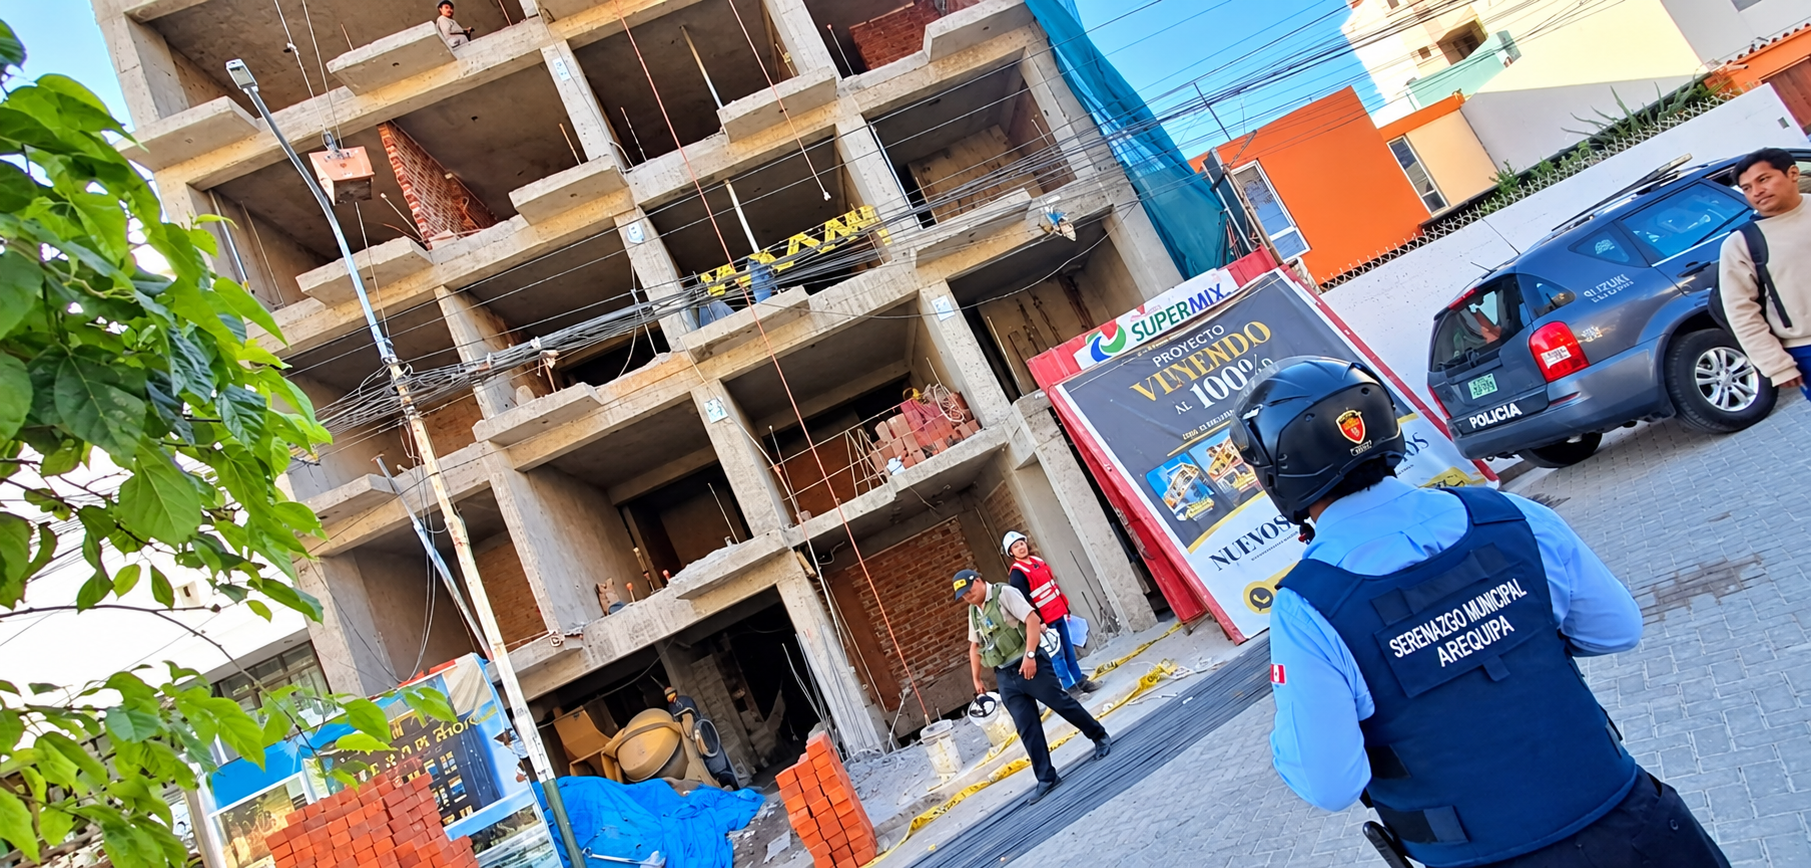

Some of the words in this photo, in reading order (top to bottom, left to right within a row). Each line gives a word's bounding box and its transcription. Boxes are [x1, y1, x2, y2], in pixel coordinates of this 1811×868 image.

[1131, 283, 1225, 342] SUPERMIX
[1152, 324, 1225, 368] PROYECTO
[1174, 401, 1193, 415] AL
[1189, 354, 1273, 410] 100%
[1469, 403, 1523, 429] POLICIA
[1208, 515, 1292, 572] NUEVOS
[1389, 608, 1467, 658] SERENAZGO
[1462, 578, 1527, 623] MUNICIPAL
[1437, 615, 1515, 667] AREQUIPA
